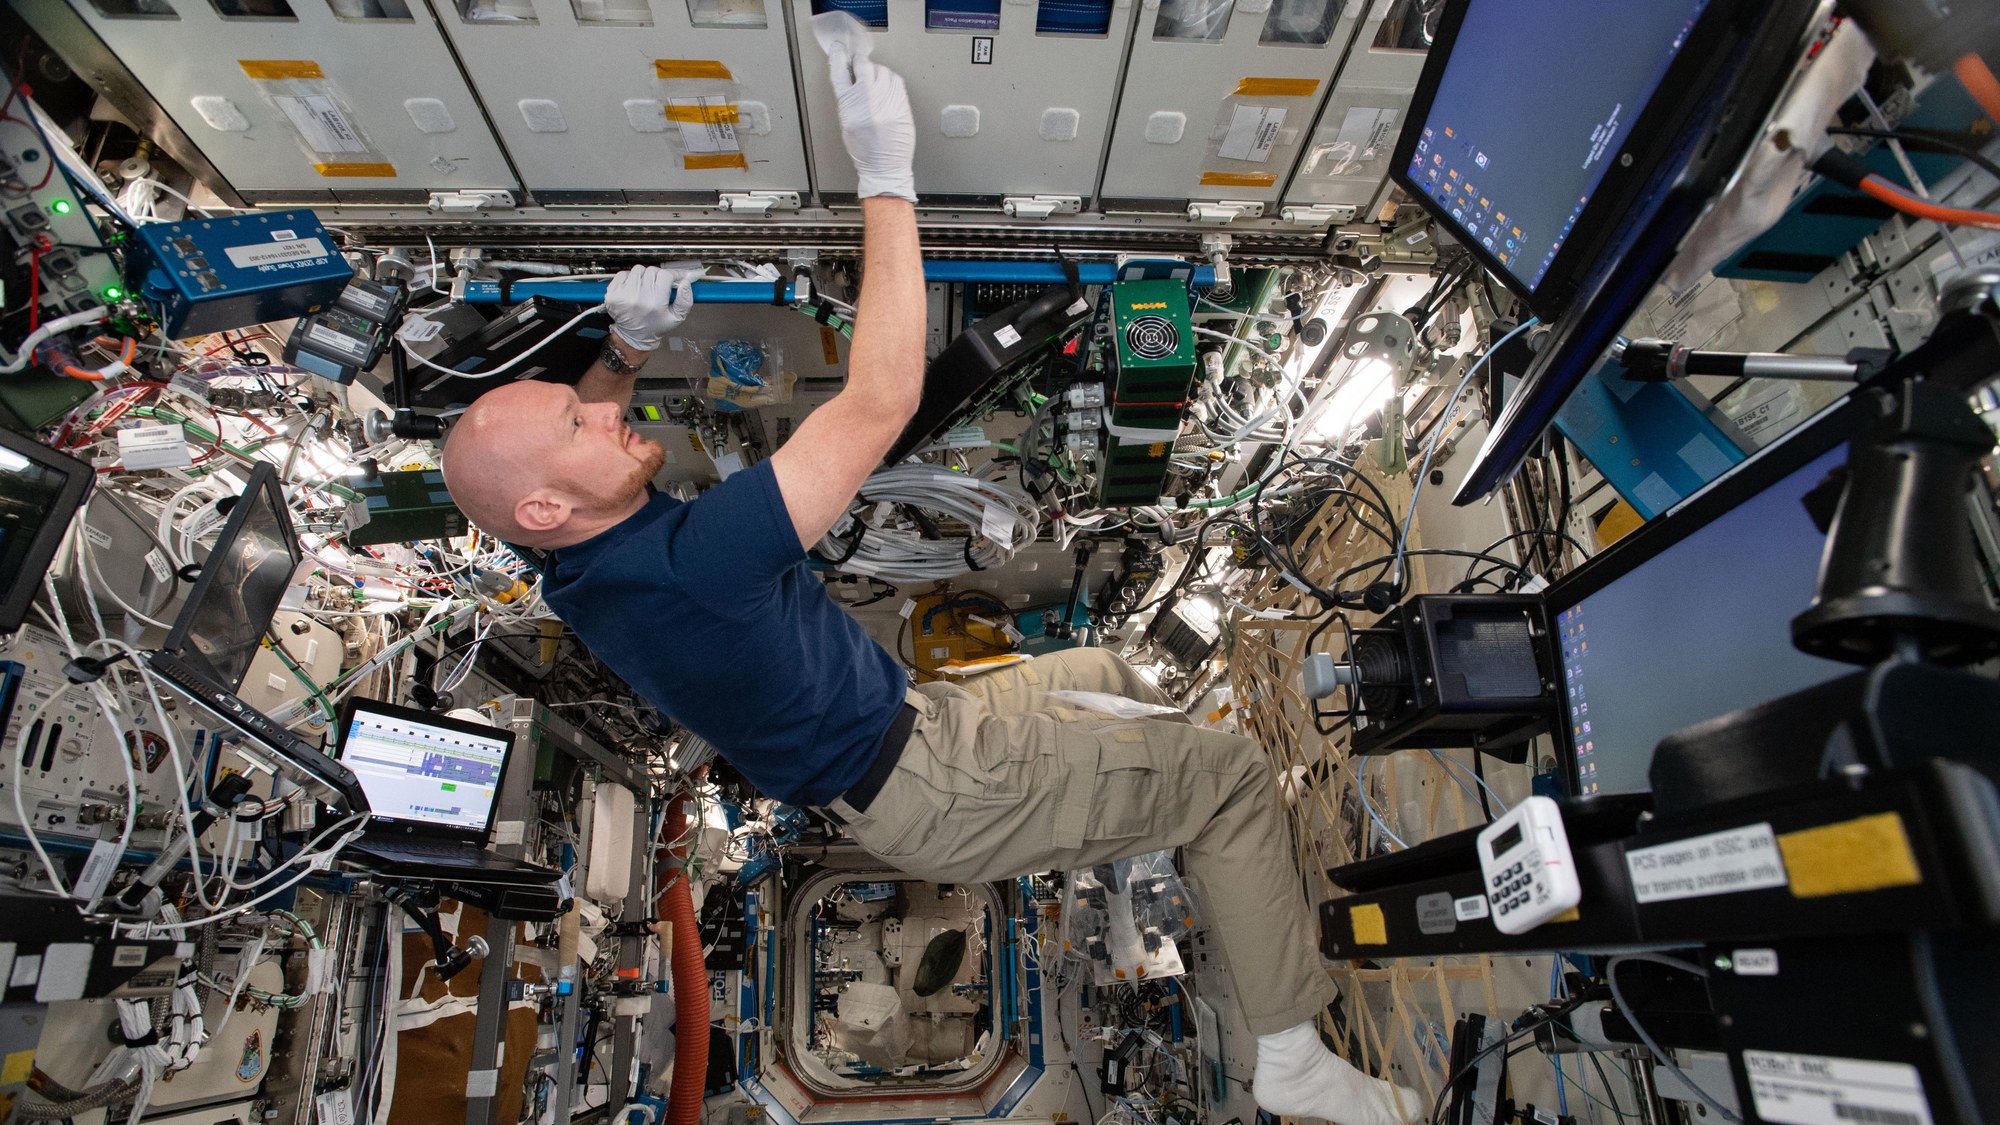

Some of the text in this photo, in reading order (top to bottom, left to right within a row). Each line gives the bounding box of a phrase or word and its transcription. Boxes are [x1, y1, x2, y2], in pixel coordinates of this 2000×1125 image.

[258, 262, 278, 273] Supply
[277, 261, 295, 270] Power
[84, 526, 110, 542] EXHAUST
[1632, 835, 1770, 871] PCS pages on SSC are
[1652, 876, 1695, 893] training
[1697, 869, 1747, 888] purpose
[1751, 864, 1779, 880] only
